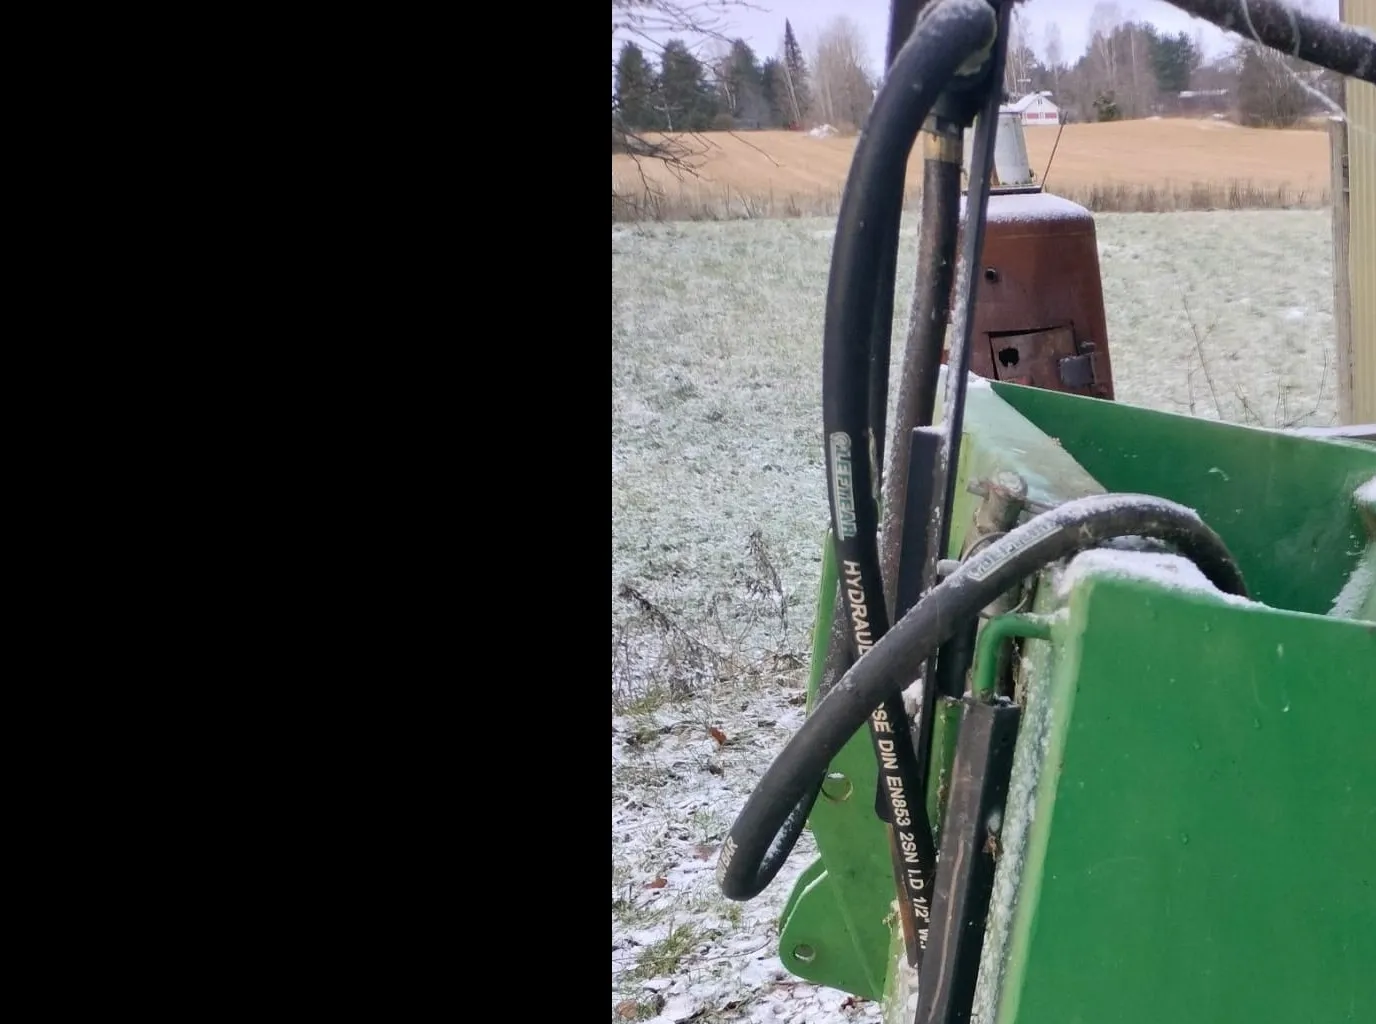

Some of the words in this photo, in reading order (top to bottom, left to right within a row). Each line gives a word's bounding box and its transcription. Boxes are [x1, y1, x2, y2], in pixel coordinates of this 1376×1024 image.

[878, 739, 899, 770] DIN
[886, 776, 911, 827] EN853
[899, 831, 920, 863] 2SN
